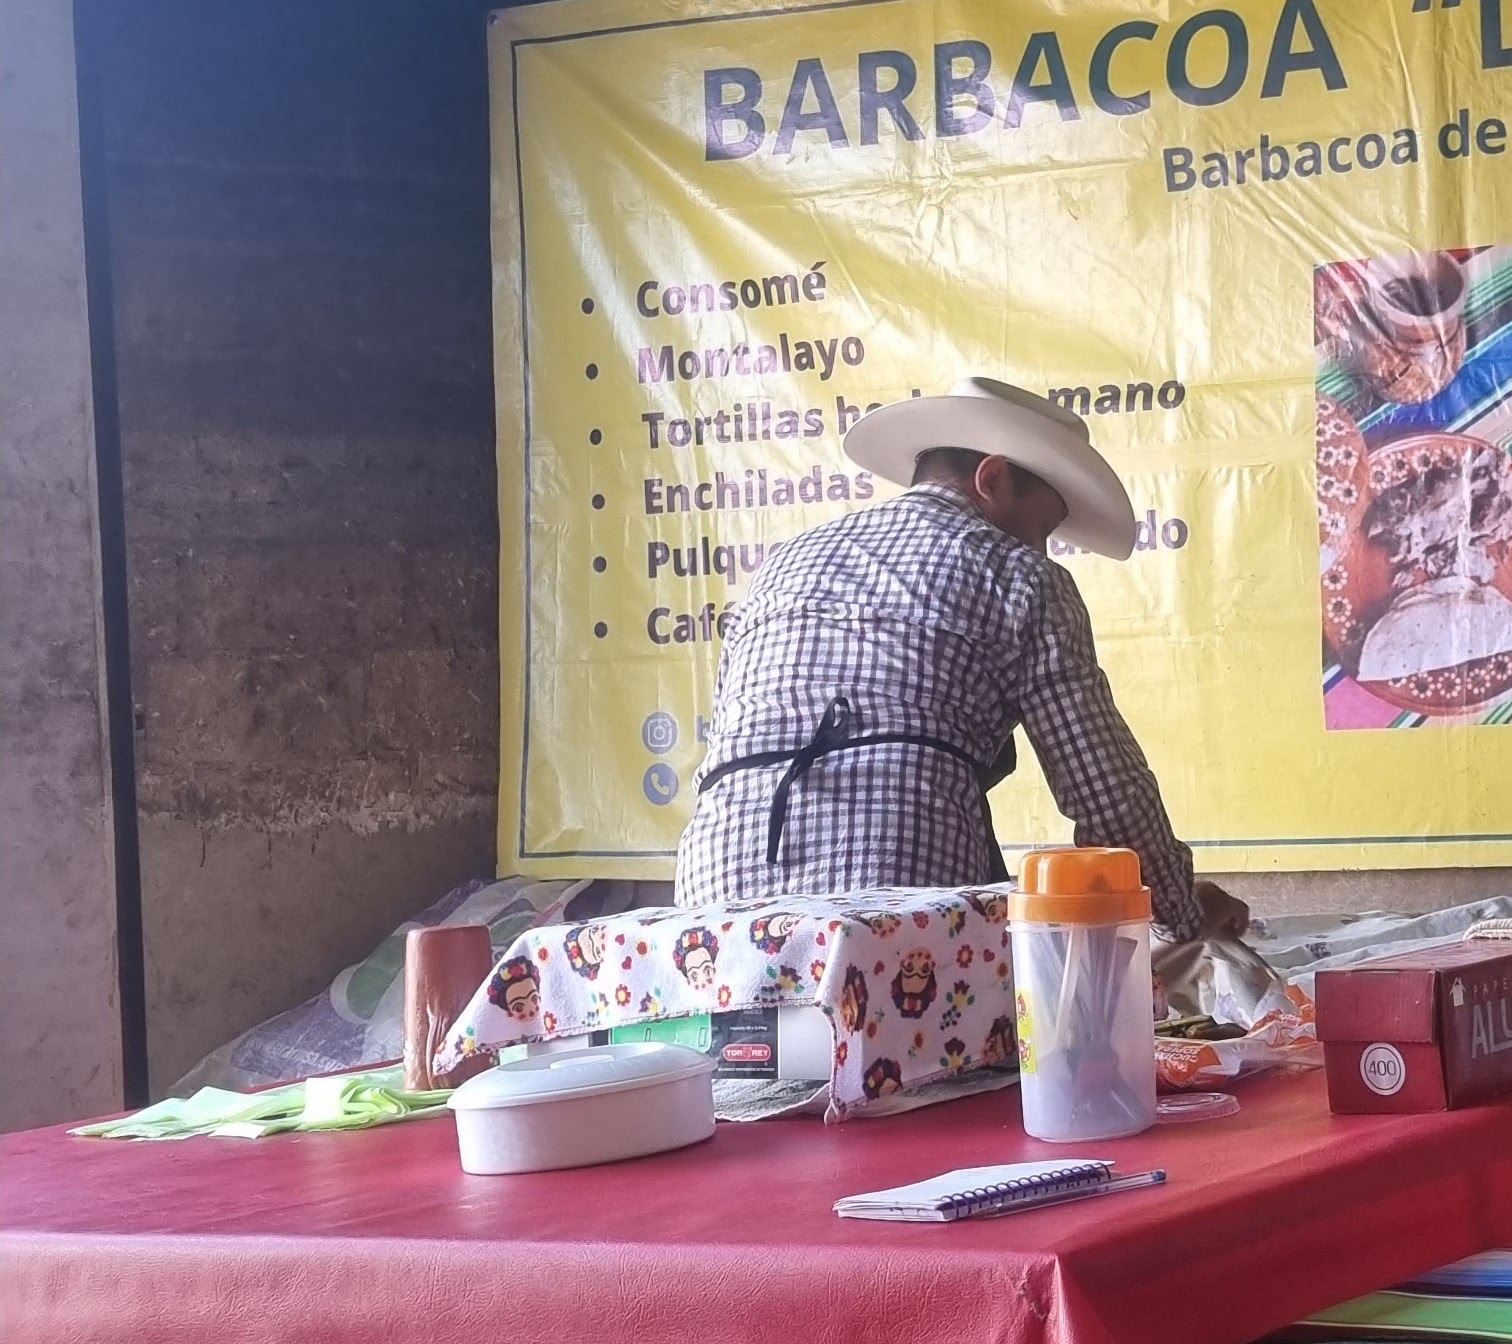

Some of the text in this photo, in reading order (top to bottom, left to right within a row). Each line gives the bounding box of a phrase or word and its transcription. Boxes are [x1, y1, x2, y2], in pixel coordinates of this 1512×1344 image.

[1163, 125, 1419, 193] Barbacoa
[1437, 109, 1506, 159] de
[636, 261, 827, 318] Consomé
[638, 333, 865, 384] Montalayo
[641, 402, 825, 449] Tortillas
[1047, 380, 1185, 417] mano
[644, 465, 875, 515] Enchiladas
[1368, 1060, 1397, 1076] 400
